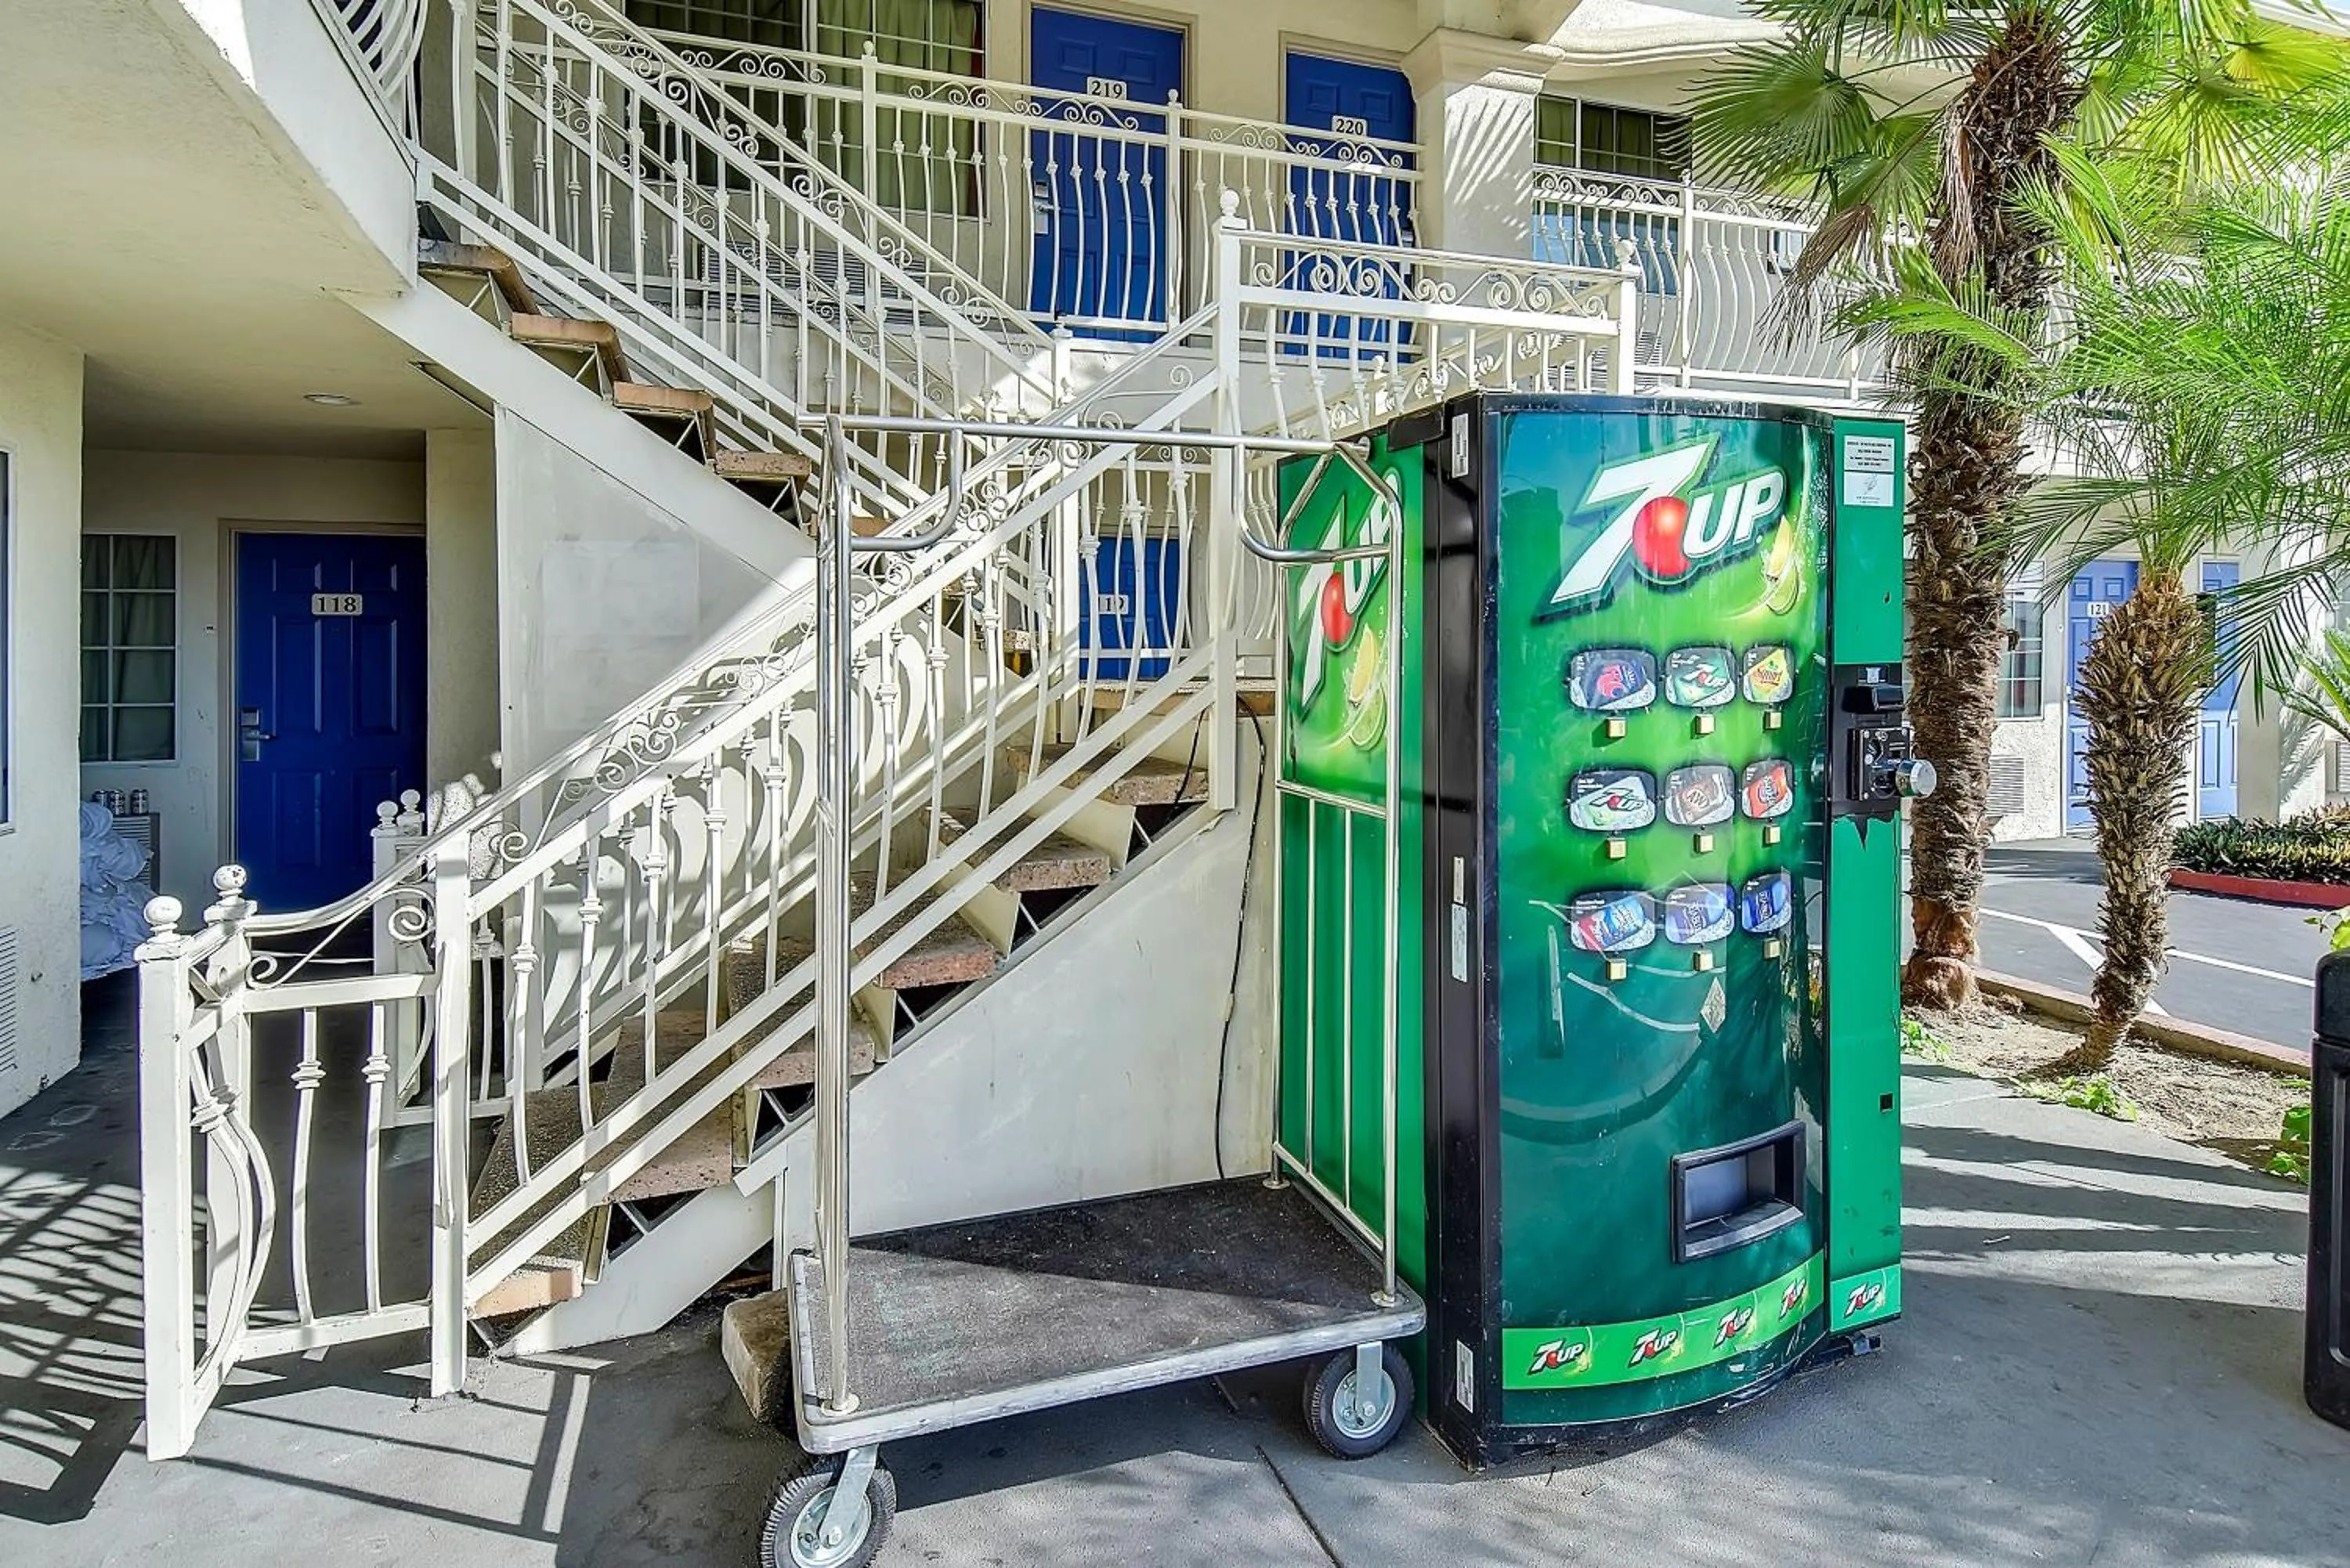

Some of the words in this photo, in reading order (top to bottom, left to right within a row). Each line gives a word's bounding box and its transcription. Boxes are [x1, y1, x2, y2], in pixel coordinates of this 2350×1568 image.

[1091, 80, 1123, 99] 219
[1336, 118, 1364, 135] 220
[1548, 439, 1786, 606] 7UP
[317, 596, 356, 613] 118
[2090, 604, 2106, 616] 121
[1845, 1282, 1882, 1317] 7UP
[1714, 1306, 1753, 1346] 7UP
[1529, 1339, 1585, 1374] 7UP
[1629, 1328, 1679, 1367] 7UP
